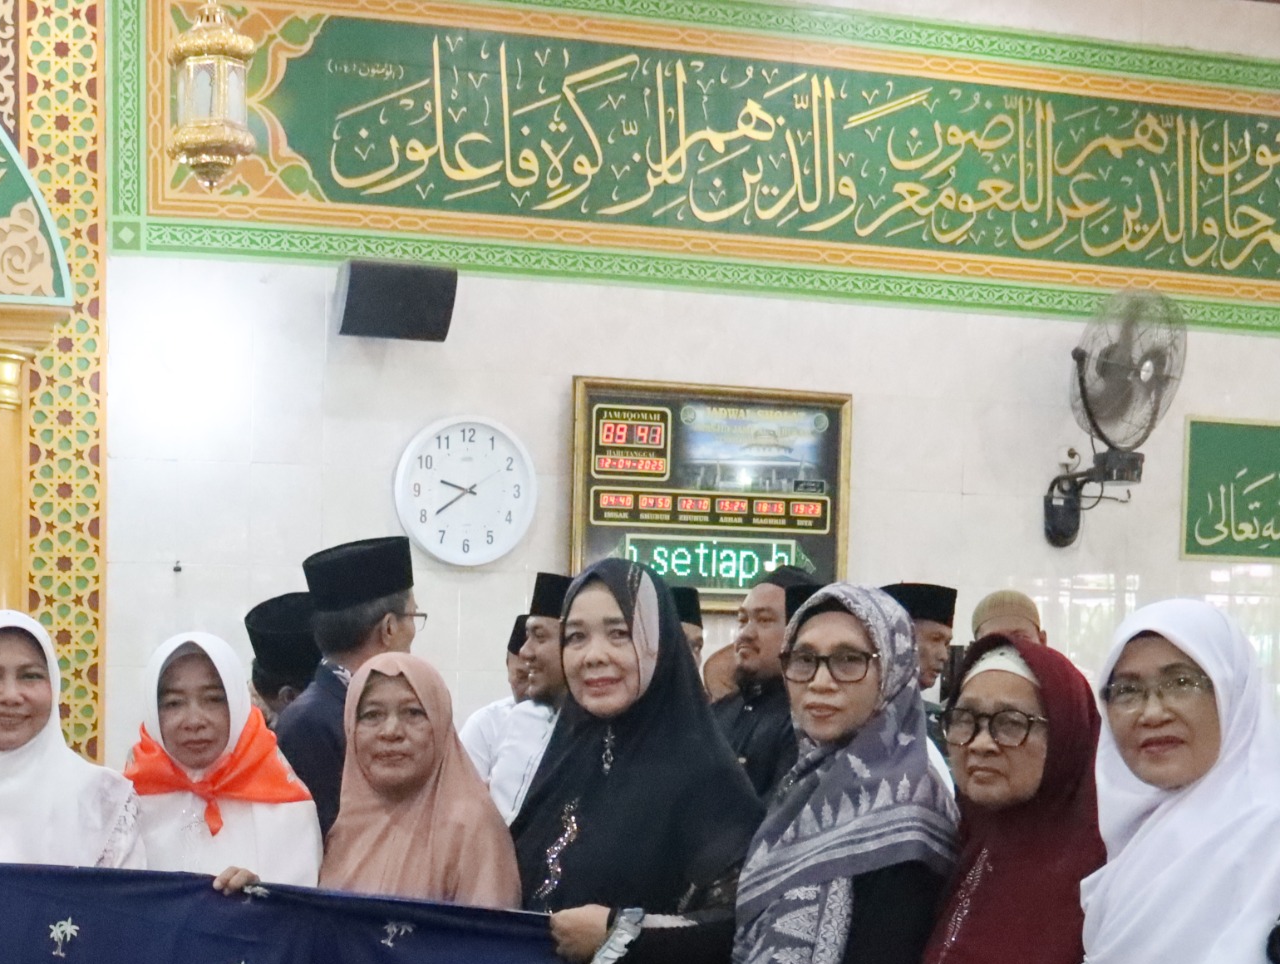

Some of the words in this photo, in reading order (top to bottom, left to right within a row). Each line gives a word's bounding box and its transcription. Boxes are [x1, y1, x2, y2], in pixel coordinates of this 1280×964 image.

[436, 435, 450, 449] 11
[460, 428, 476, 442] 12
[489, 436, 495, 450] 1
[417, 455, 433, 470] 10
[506, 456, 514, 471] 2
[599, 458, 663, 471] 12-04-2025
[413, 483, 421, 497] 9
[513, 484, 521, 499] 3
[420, 509, 427, 523] 8
[505, 510, 513, 524] 4
[438, 530, 446, 544] 7
[486, 531, 494, 545] 5
[462, 539, 470, 553] 6
[651, 540, 759, 587] setiap
